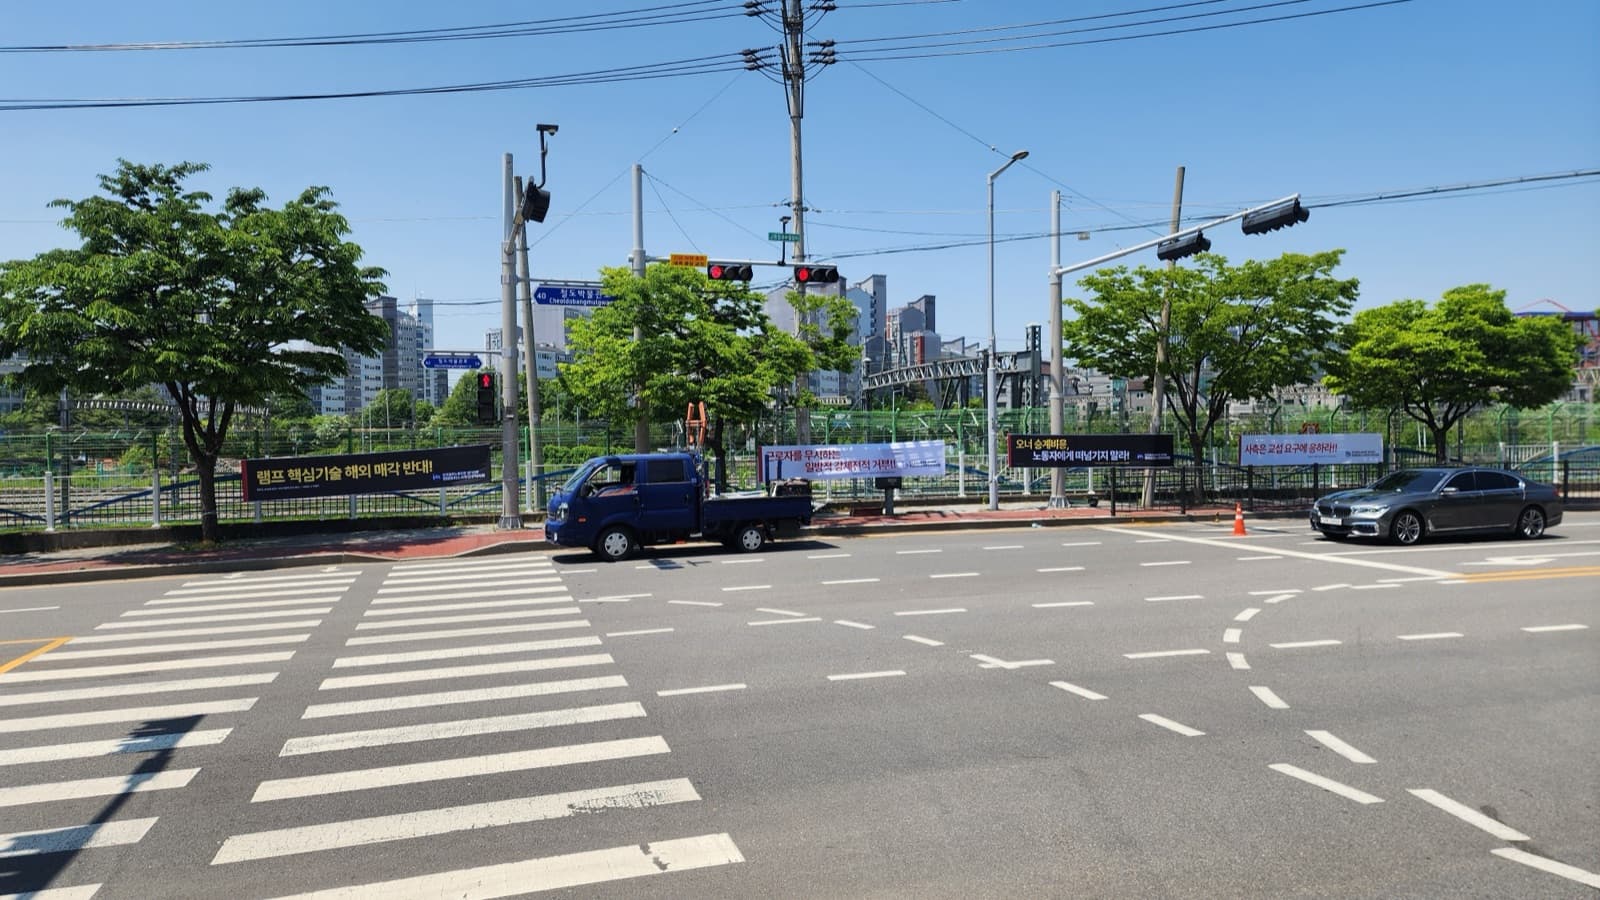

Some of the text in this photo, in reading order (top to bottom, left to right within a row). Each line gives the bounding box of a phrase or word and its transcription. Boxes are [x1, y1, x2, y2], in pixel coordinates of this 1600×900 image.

[536, 292, 547, 300] 40
[1016, 439, 1033, 450] 오너
[1245, 443, 1266, 455] 사측은
[1268, 443, 1283, 454] 교섭
[1284, 442, 1308, 454] 요구에
[805, 449, 841, 461] 무시하는
[1032, 450, 1074, 461] 노동자에게
[1075, 449, 1109, 461] 떠넘기지
[1110, 449, 1130, 461] 말라!
[256, 469, 286, 485] 램프
[287, 466, 343, 483] 핵심기술
[345, 463, 372, 479] 해외
[374, 461, 400, 477] 매각
[402, 459, 434, 476] 반대!
[805, 460, 832, 473] 일방적
